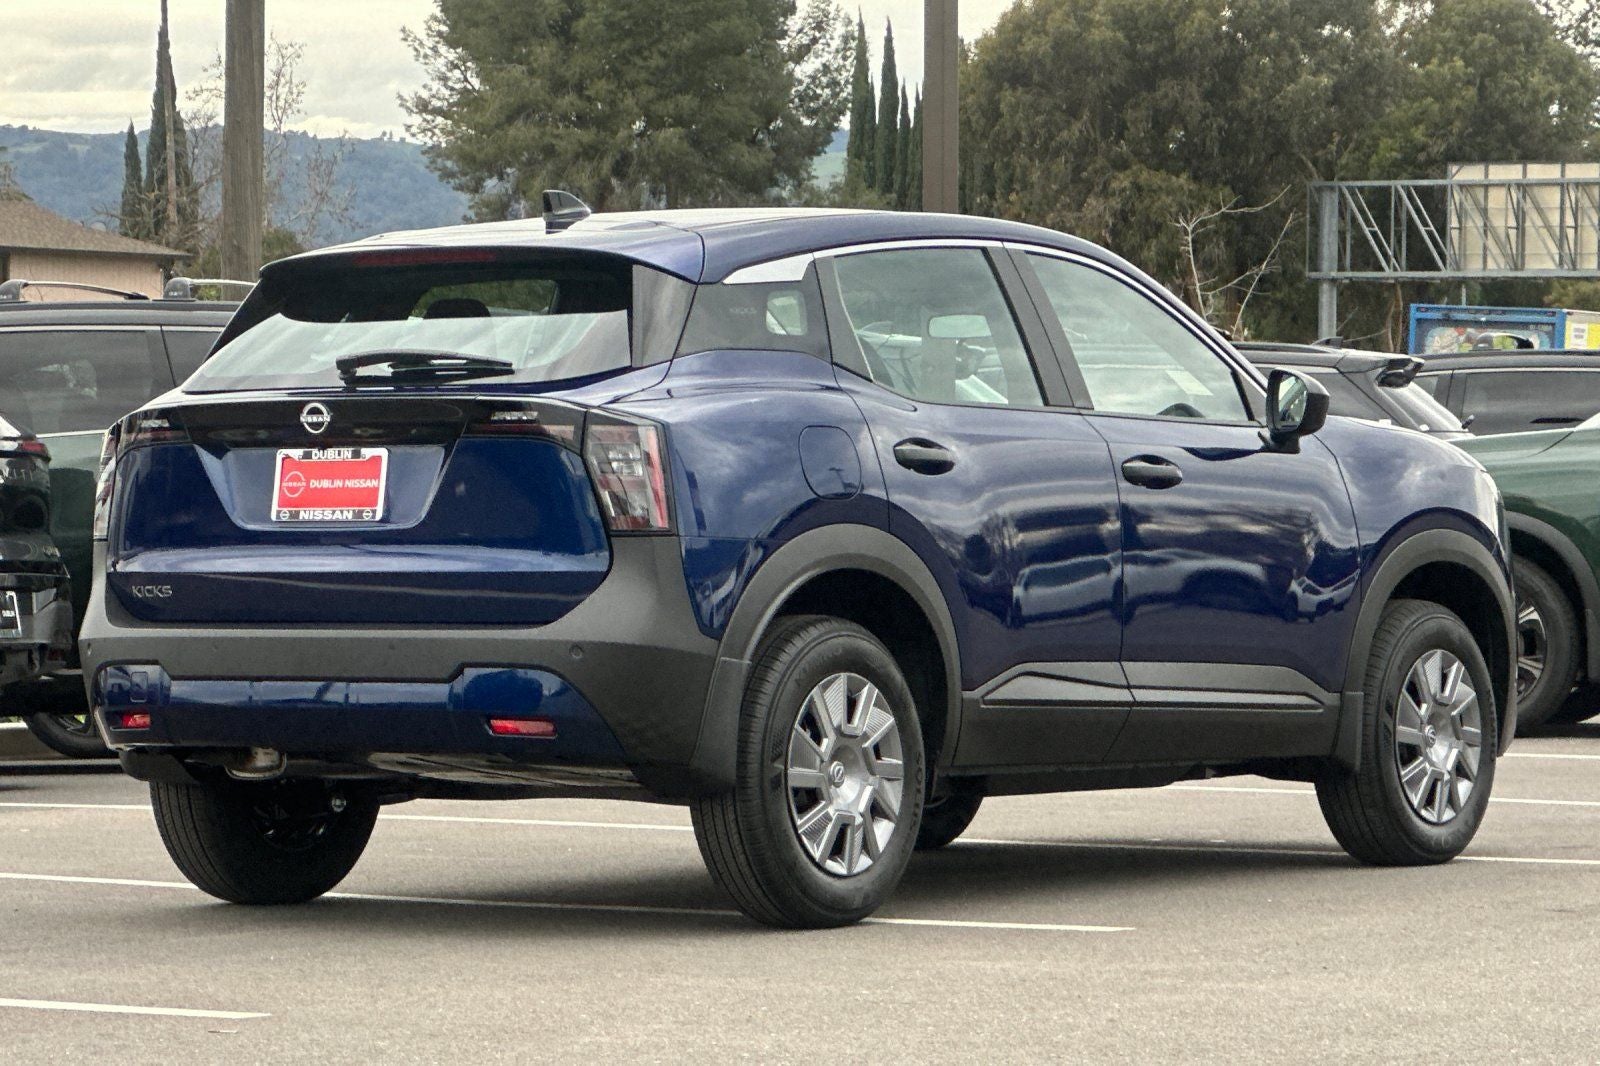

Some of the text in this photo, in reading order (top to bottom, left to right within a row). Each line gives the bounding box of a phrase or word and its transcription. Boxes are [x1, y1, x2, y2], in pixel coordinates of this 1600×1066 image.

[300, 414, 331, 423] NISSAN
[311, 449, 352, 460] DUBLIN
[309, 479, 379, 489] DUBLIN NISSAN
[299, 510, 353, 520] NISSAN
[131, 585, 173, 598] KICKS
